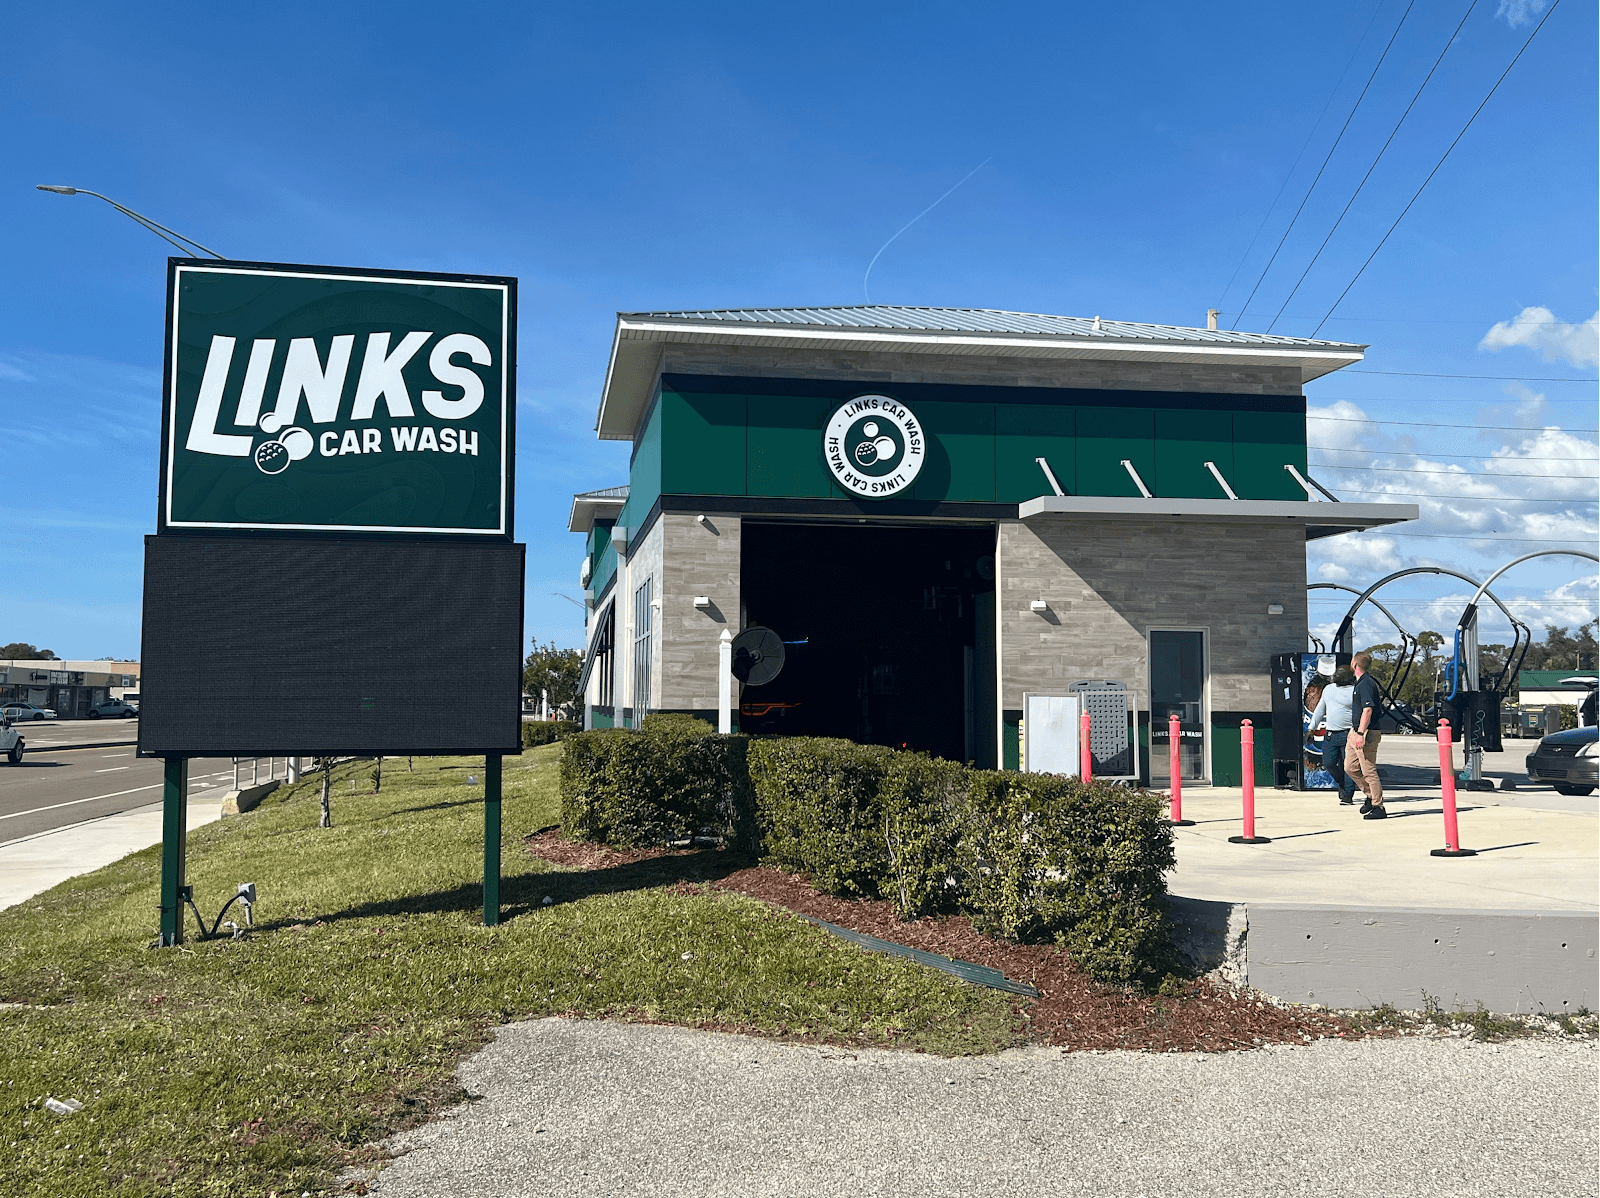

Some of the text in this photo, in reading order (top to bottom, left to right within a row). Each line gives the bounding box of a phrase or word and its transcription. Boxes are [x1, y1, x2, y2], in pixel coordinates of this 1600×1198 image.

[185, 331, 492, 457] LINKS
[319, 427, 479, 457] CAR WASH
[844, 399, 921, 455] LINKS CAR WASH
[829, 437, 906, 493] LINKS CAR WASH
